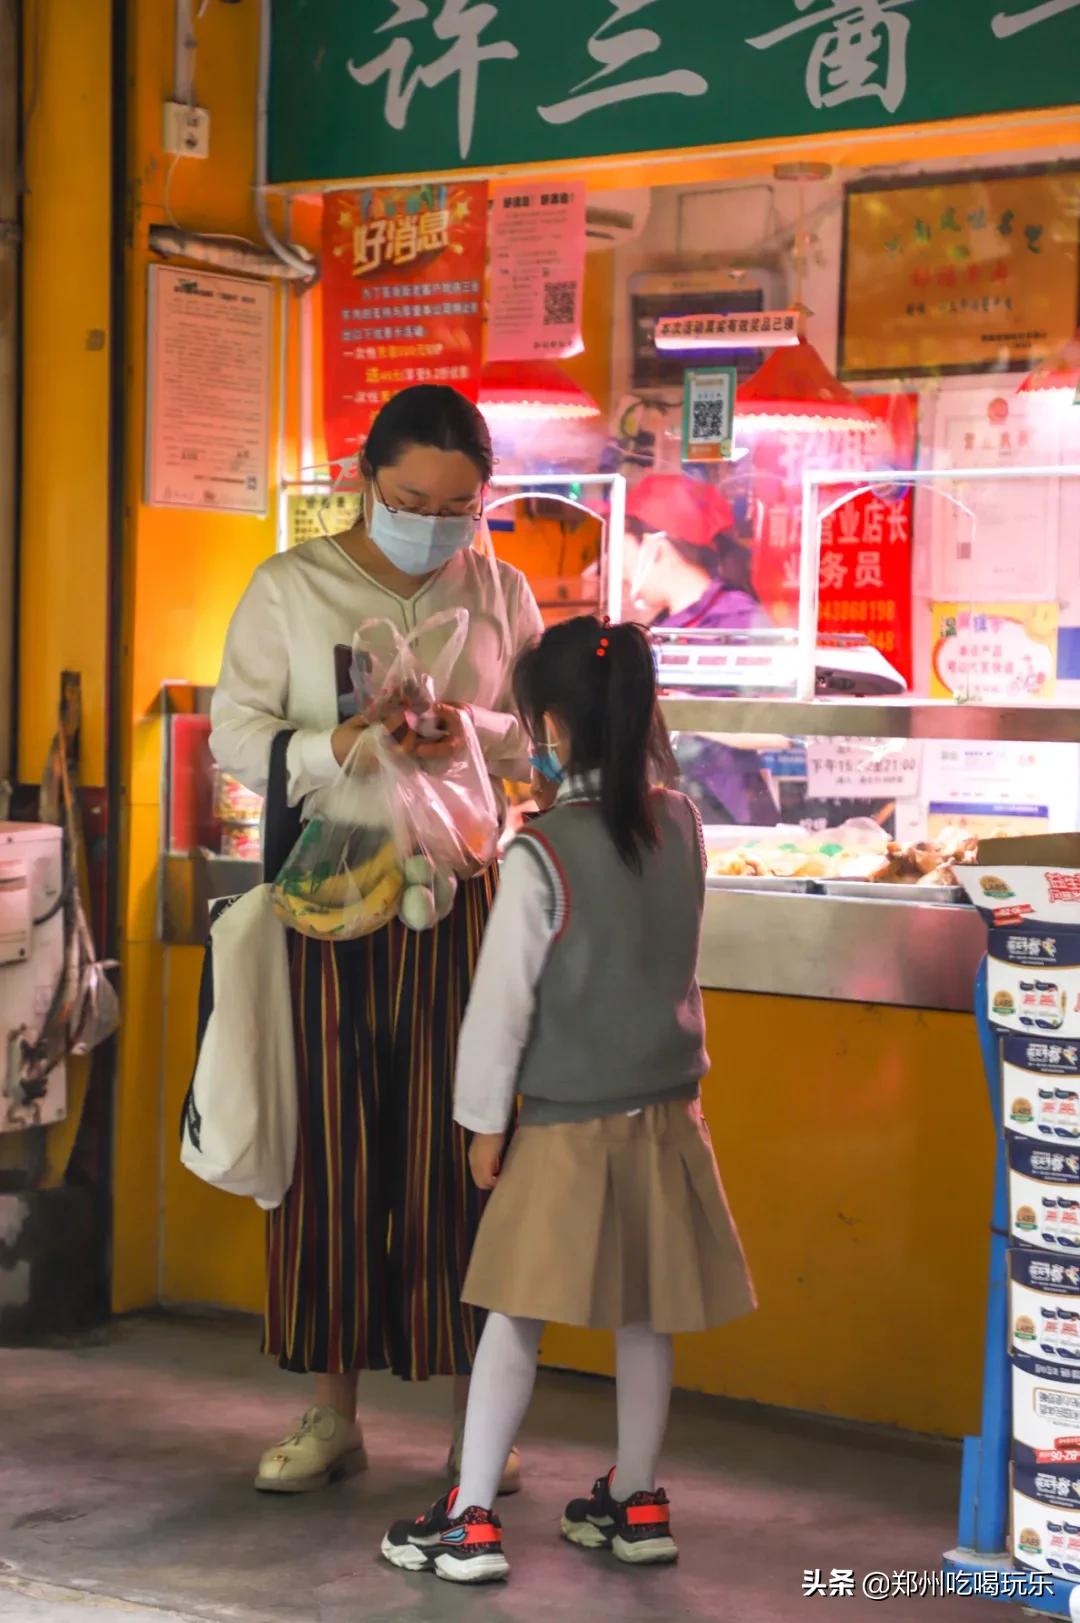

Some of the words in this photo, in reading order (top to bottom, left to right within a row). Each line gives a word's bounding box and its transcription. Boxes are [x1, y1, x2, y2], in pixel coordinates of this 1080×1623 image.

[352, 208, 450, 277] 好消息
[782, 550, 884, 589] 业务员
